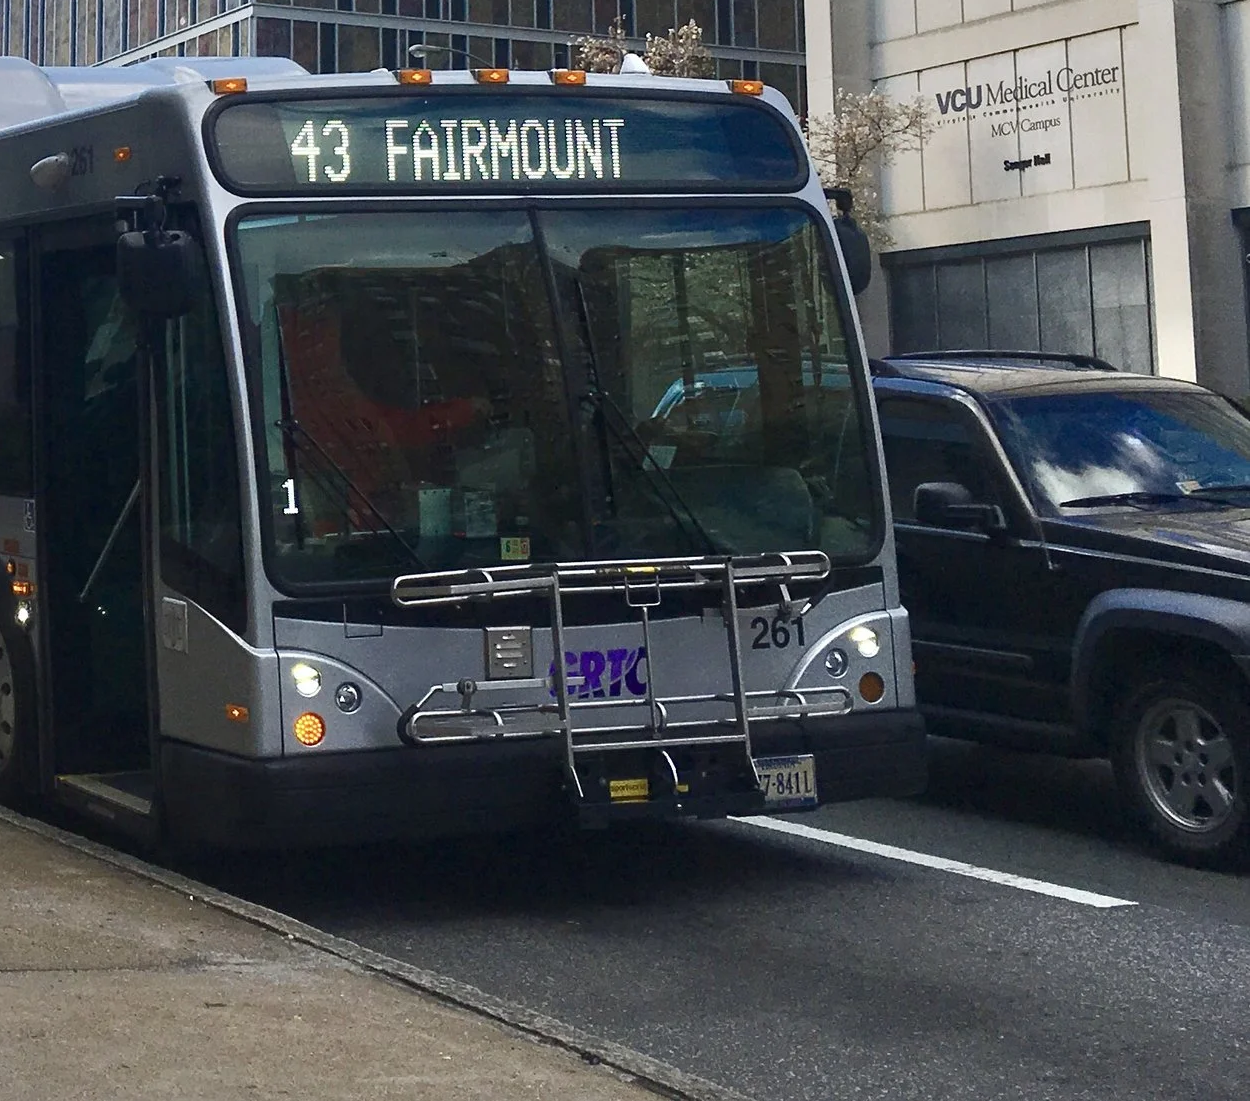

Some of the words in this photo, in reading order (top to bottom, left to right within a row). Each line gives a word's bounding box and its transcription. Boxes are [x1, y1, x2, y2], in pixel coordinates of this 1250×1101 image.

[936, 85, 982, 115] VCU
[986, 71, 1053, 107] Medical
[1056, 66, 1119, 93] Center
[290, 119, 350, 182] 43
[386, 118, 626, 182] FAIRMOUNT
[991, 119, 1019, 138] MCV
[1020, 117, 1061, 135] Campus
[752, 614, 806, 650] 261
[550, 646, 648, 699] GRTC
